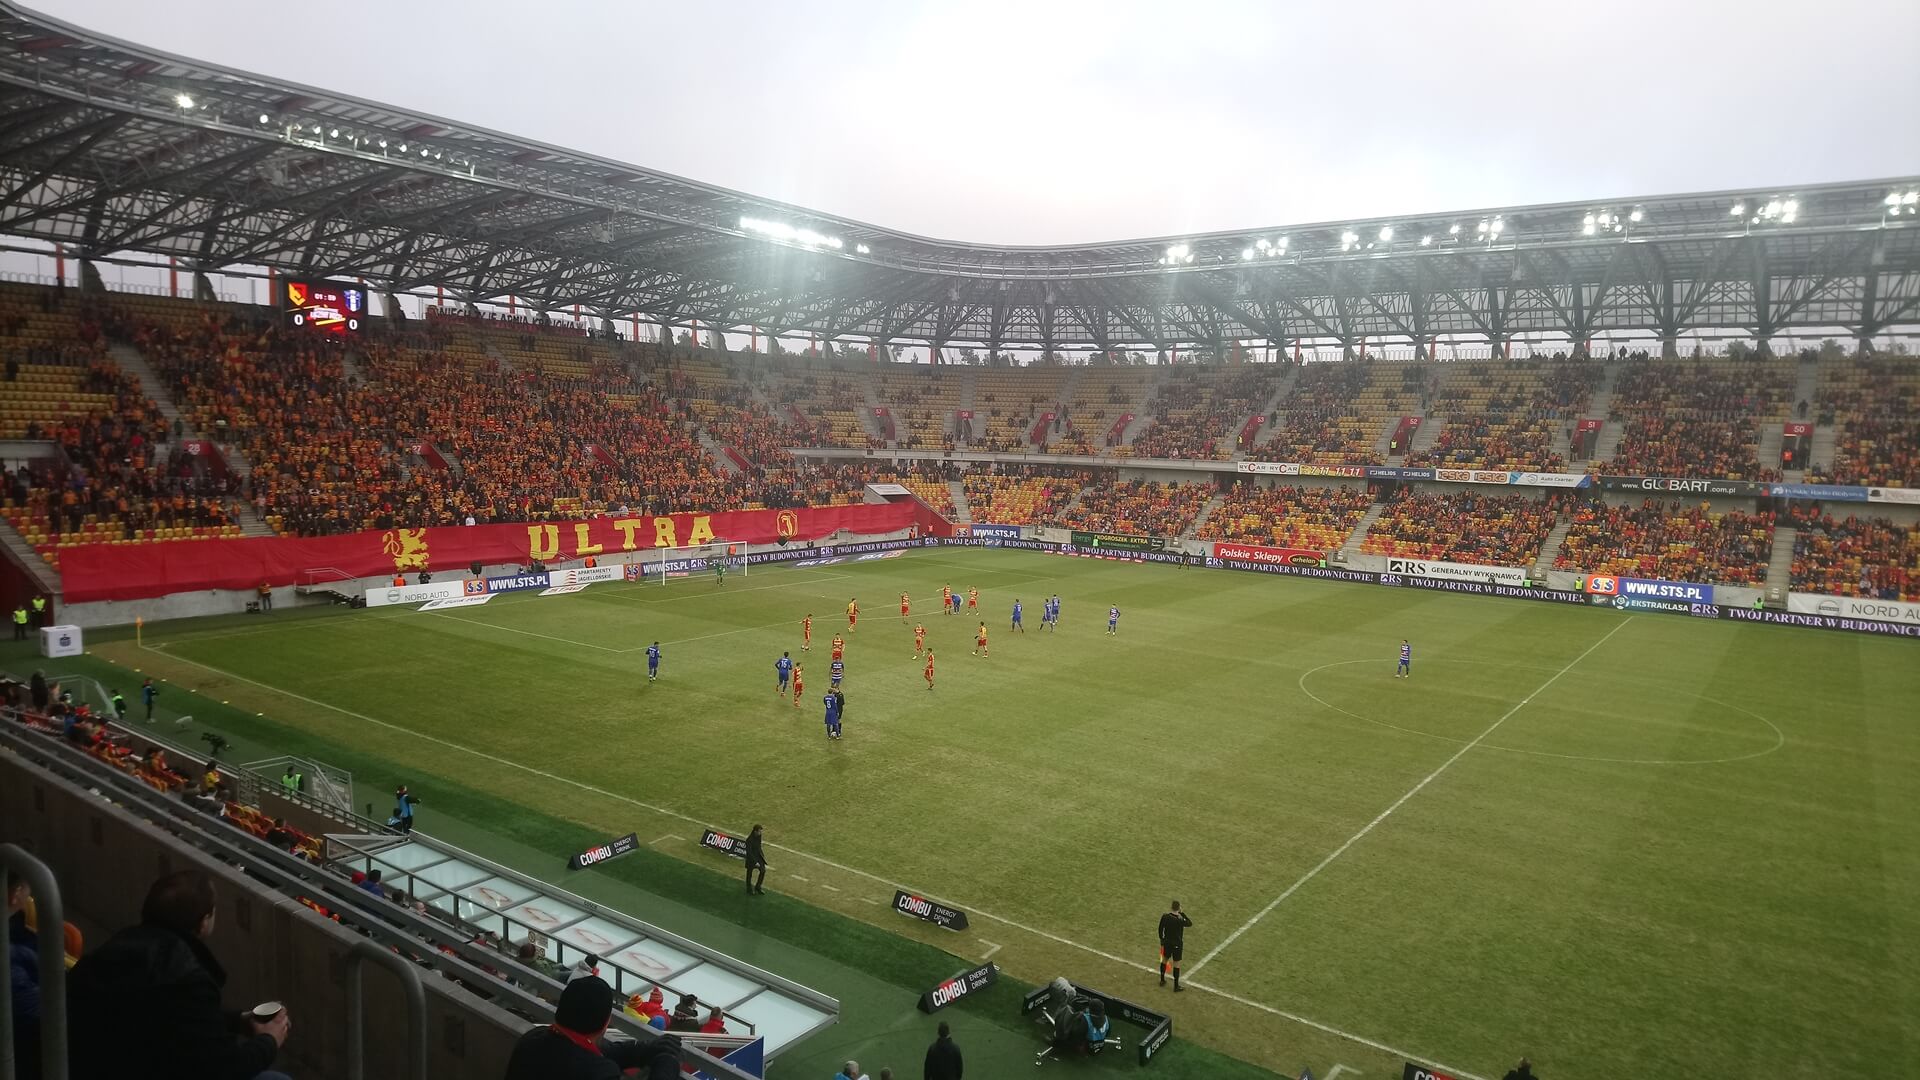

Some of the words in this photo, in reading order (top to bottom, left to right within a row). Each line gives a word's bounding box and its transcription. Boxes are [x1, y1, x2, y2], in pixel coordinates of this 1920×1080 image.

[294, 314, 303, 325] 0
[349, 319, 357, 330] 0
[532, 316, 575, 329] KRJOWA
[528, 516, 716, 561] ULTRA
[733, 555, 761, 565] PARNER
[1100, 548, 1131, 558] PARTNER
[1141, 552, 1201, 565] BUDOWNICTIE!
[1220, 548, 1250, 558] Polskie
[1254, 551, 1284, 563] Sklepy
[643, 562, 689, 574] WWWSTS.PL
[1229, 560, 1251, 570] TWÓJ
[1253, 564, 1290, 574] PARTNER
[1302, 567, 1374, 582] BUDOWNICTWIE!
[1405, 562, 1426, 575] RS
[1431, 566, 1473, 576] GENERALNY
[1474, 570, 1522, 581] WYKONAWCA
[489, 575, 548, 591] WWW.STS.PL
[1409, 576, 1435, 587] TWÓJ
[1438, 581, 1482, 592] PARTNER
[1485, 585, 1495, 593] W
[1497, 585, 1583, 603] BUDOWNICTWIE!
[1592, 577, 1615, 592] STS
[405, 593, 427, 602] NORD
[430, 590, 449, 599] AUTO
[1626, 582, 1703, 600] WWW.STS.PL
[1632, 599, 1689, 612] EKSTRAKLASA
[1852, 603, 1899, 618] NORD
[1703, 604, 1720, 616] RS
[1728, 608, 1762, 621] TWÓJ
[1765, 613, 1823, 627] PARTNER
[1826, 618, 1838, 628] W
[614, 836, 633, 848] ENERGY
[706, 832, 734, 850] COMBU
[580, 846, 611, 866] COMBU
[616, 844, 631, 854] DRINK
[899, 895, 932, 917] COMBU
[935, 907, 957, 920] ENERGY
[933, 913, 952, 925] DRINK
[969, 967, 989, 982] ENERGY
[971, 976, 989, 989] DRINK
[932, 979, 968, 1007] COMBU
